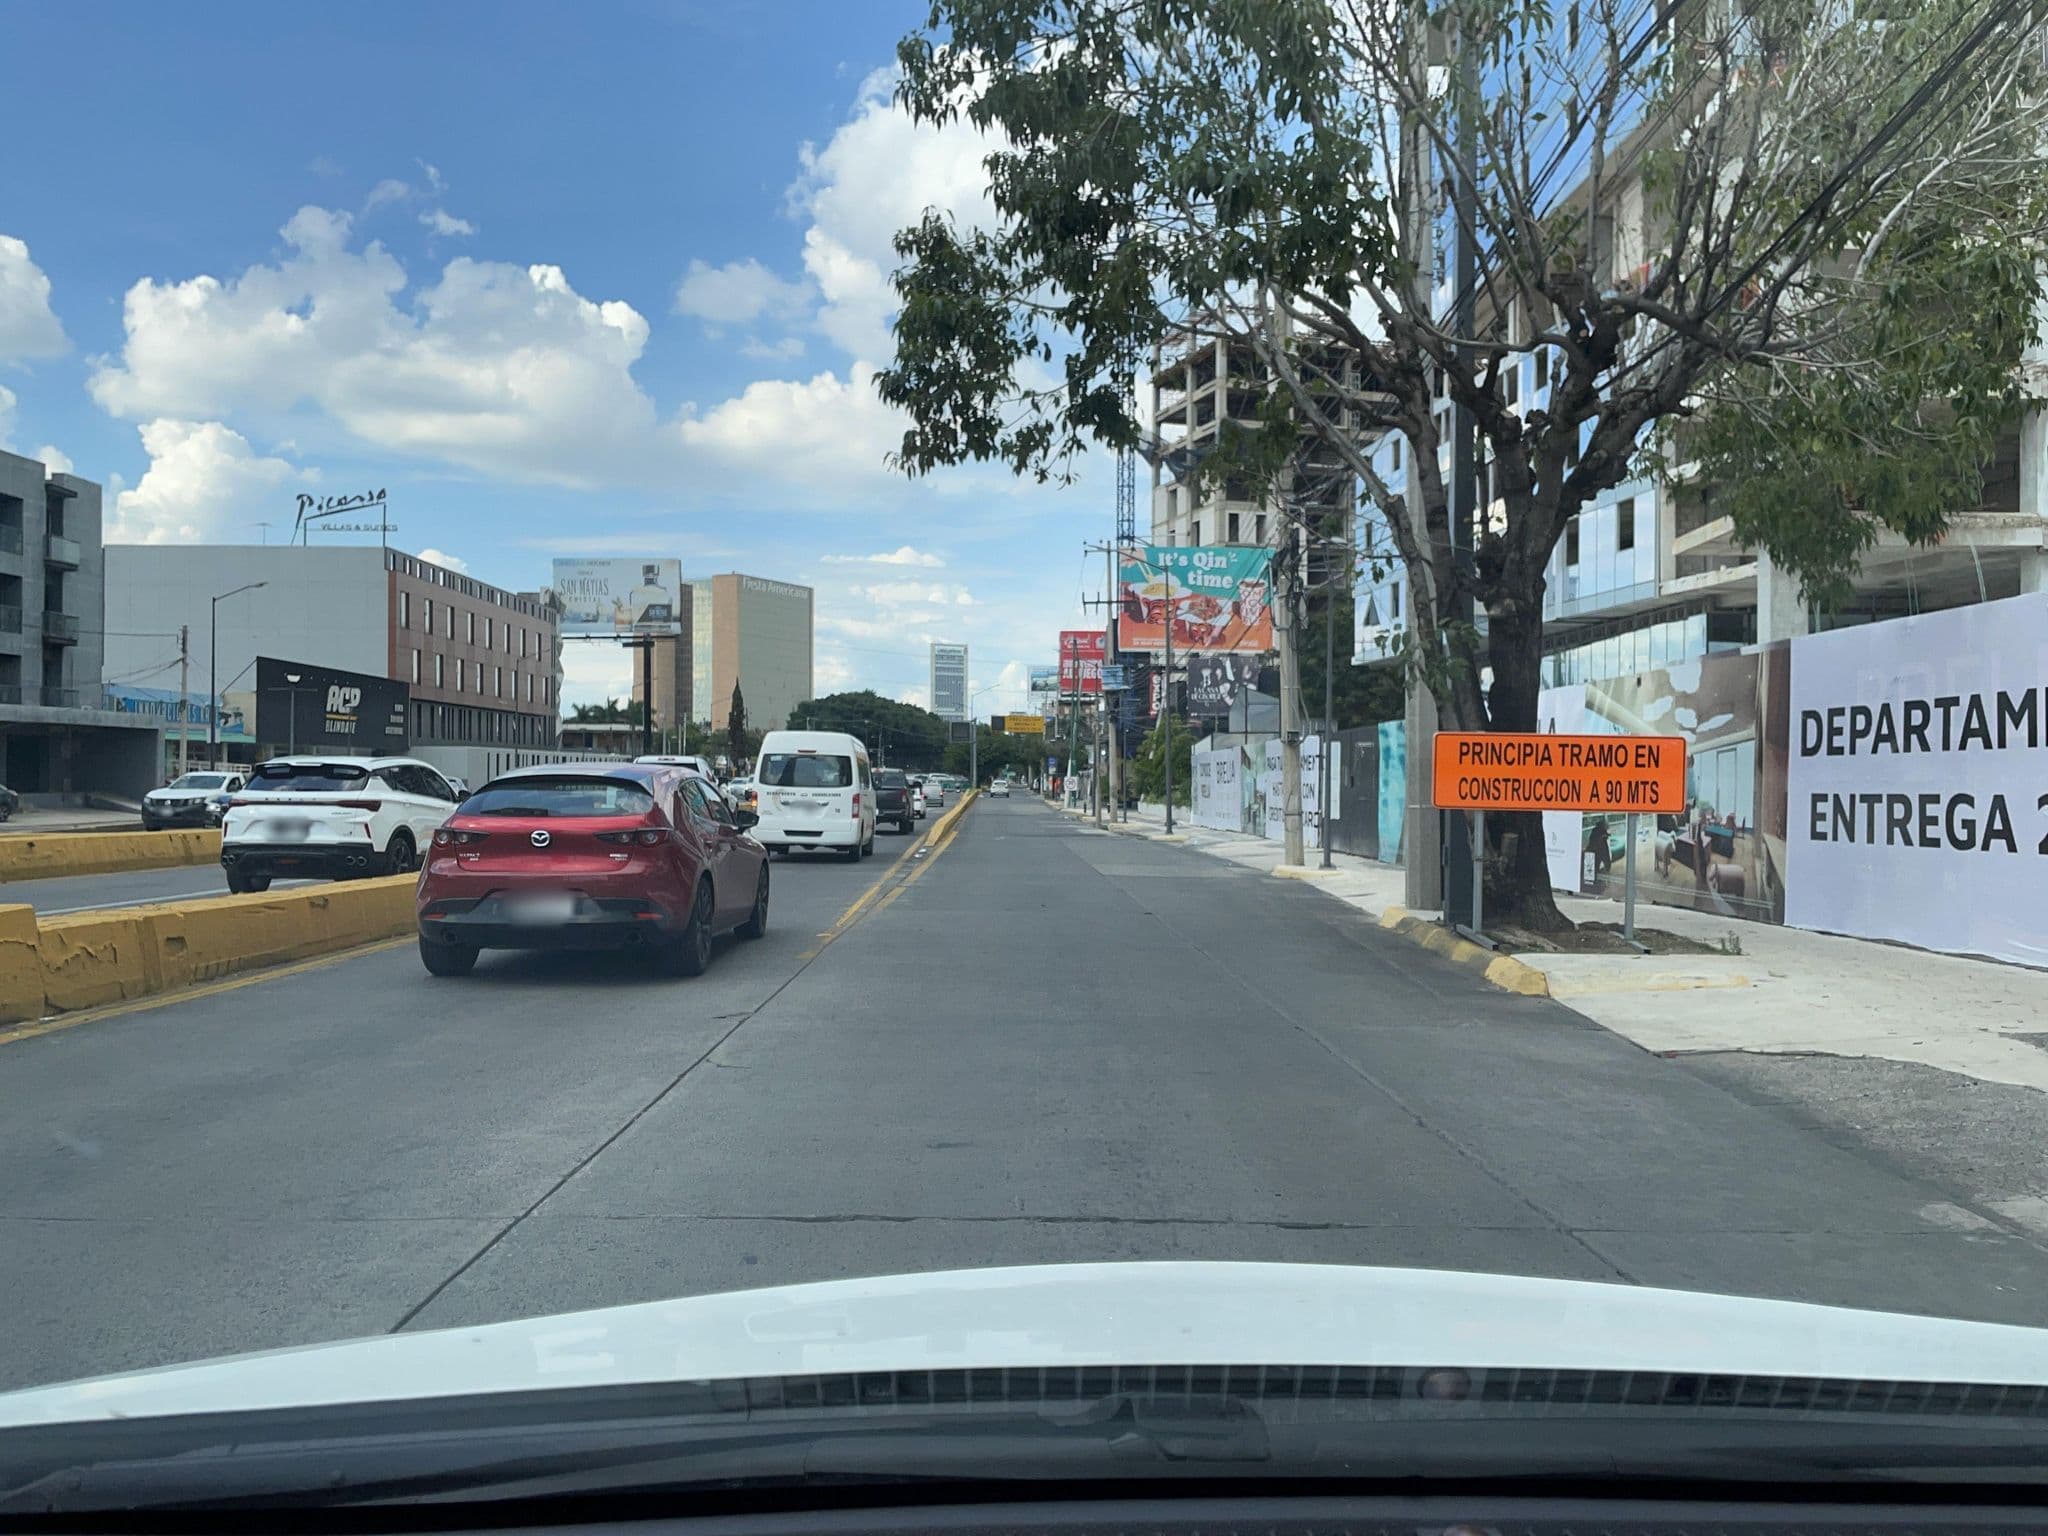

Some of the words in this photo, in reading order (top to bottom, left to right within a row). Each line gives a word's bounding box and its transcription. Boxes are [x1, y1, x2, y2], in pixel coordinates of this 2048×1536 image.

[1158, 552, 1188, 567] It's
[1192, 551, 1227, 571] Qin
[560, 579, 577, 596] SAN
[742, 577, 767, 593] Fiesta
[767, 582, 809, 600] Americana
[1187, 569, 1233, 590] time
[1800, 686, 2048, 757] DEPARTAM
[1458, 741, 1553, 768] PRINCIPIA
[1558, 743, 1628, 769] TRAMO
[1634, 744, 1660, 769] EN
[1458, 777, 1582, 803] CONSTRUCCION
[1589, 780, 1600, 803] A
[1606, 780, 1623, 804] 90
[1627, 780, 1659, 804] MTS
[1810, 793, 2018, 854] ENTREGA
